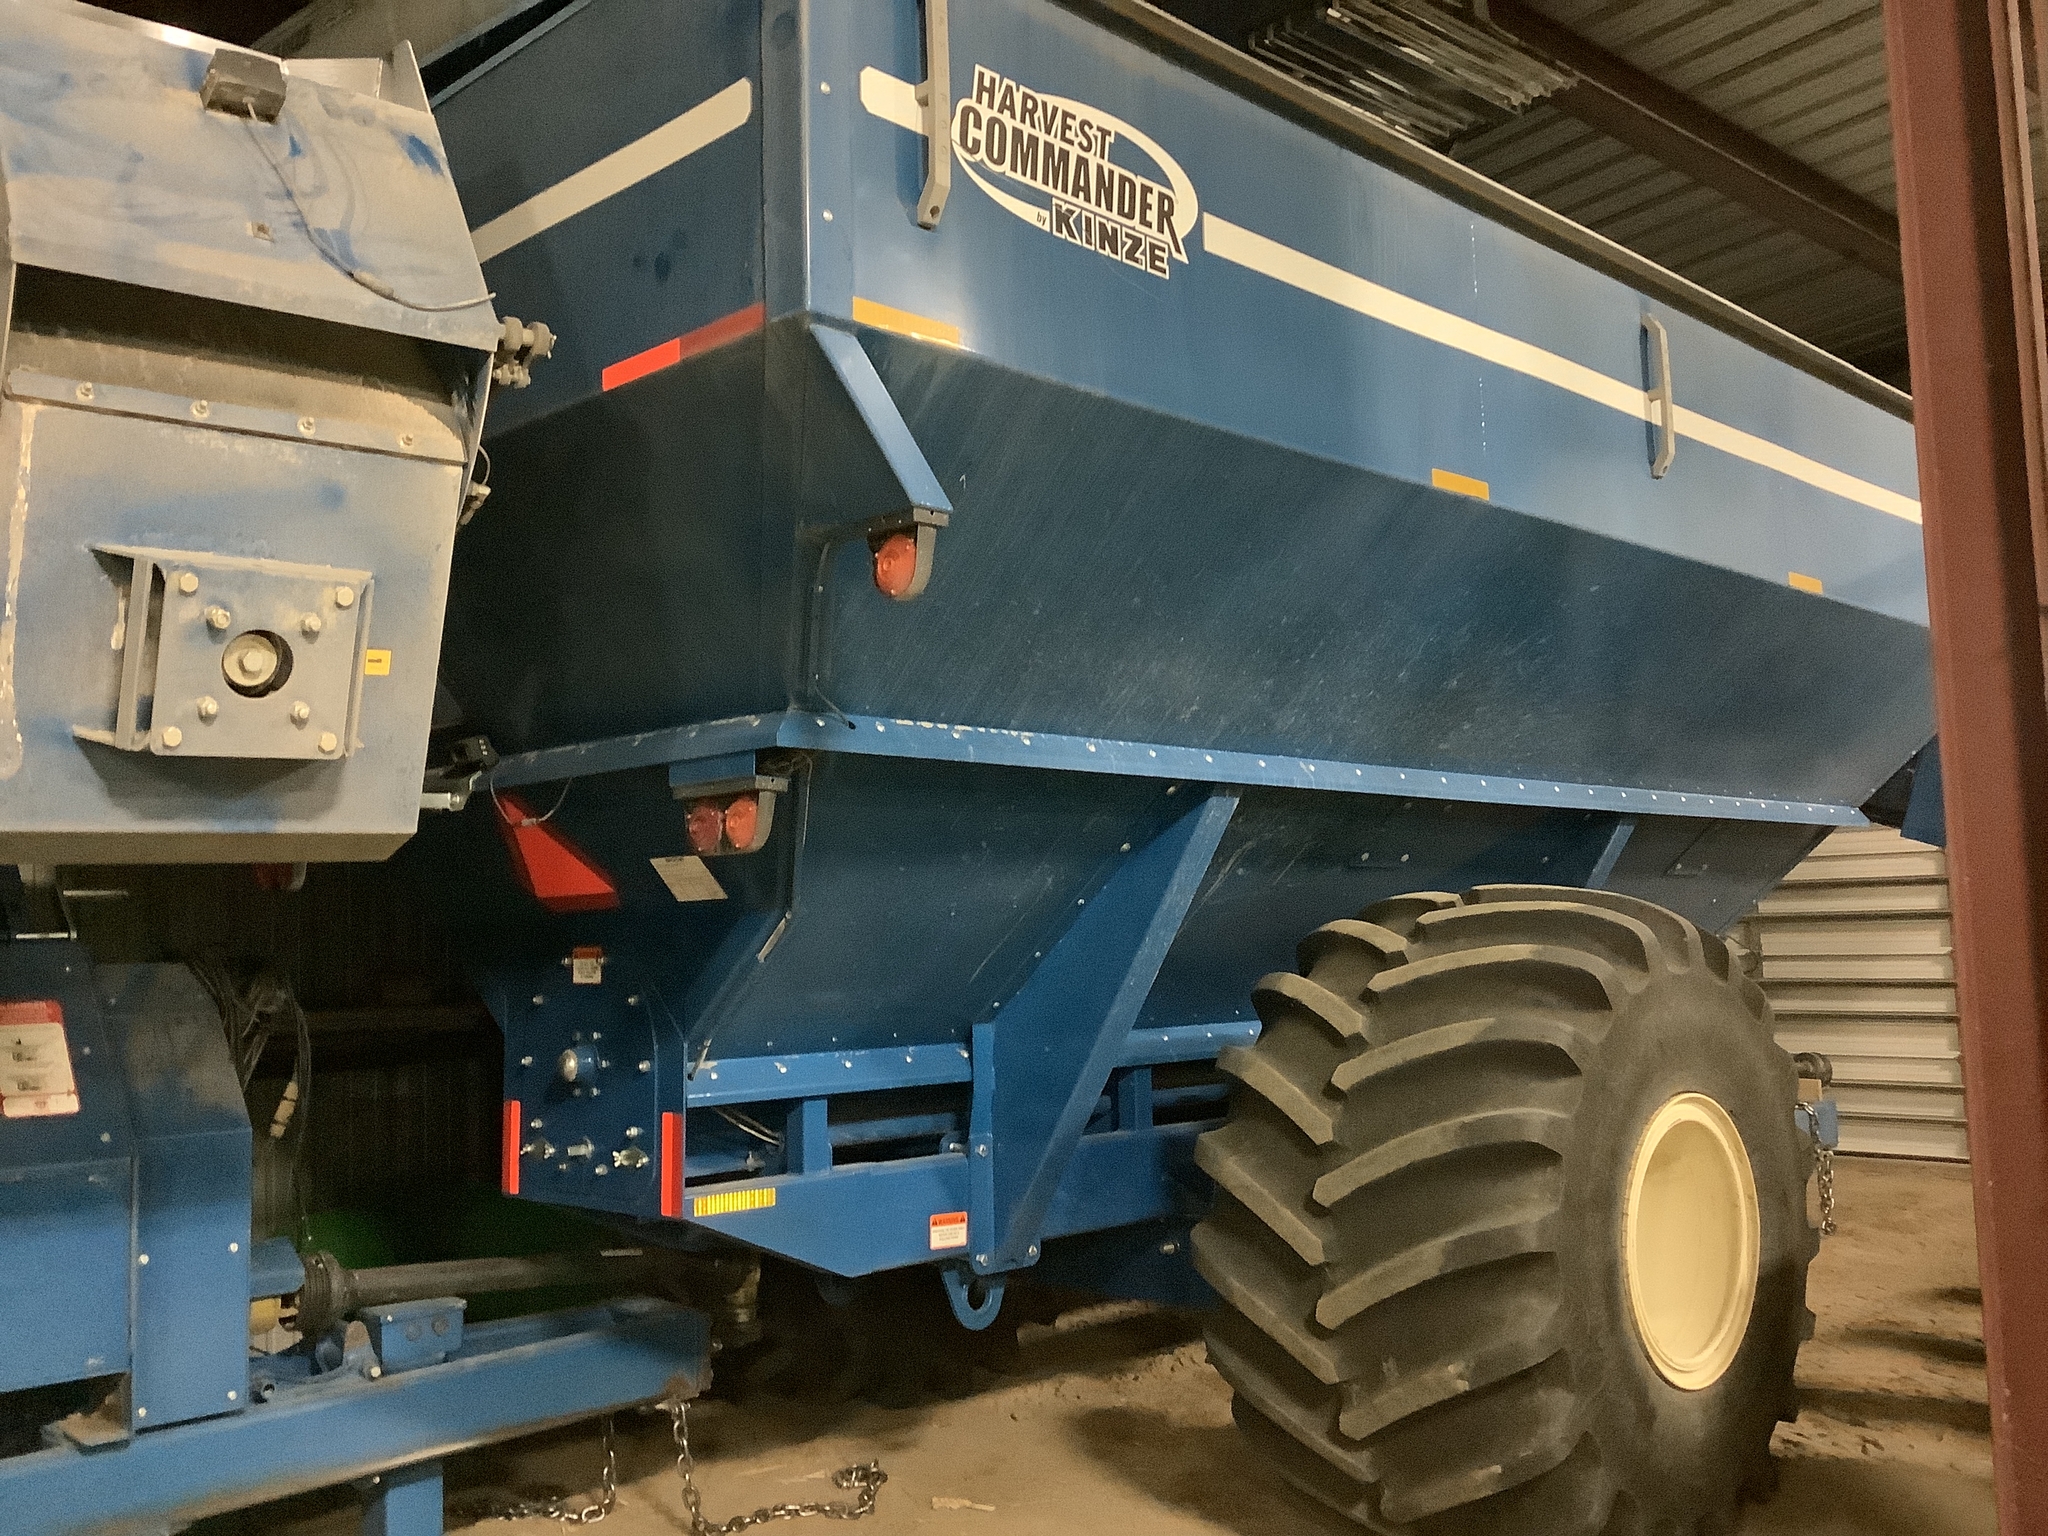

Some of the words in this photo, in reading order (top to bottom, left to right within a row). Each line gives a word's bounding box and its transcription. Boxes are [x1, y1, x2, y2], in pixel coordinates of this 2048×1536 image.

[975, 70, 1111, 159] HARVEST
[958, 105, 1182, 256] COMMANDER
[1036, 211, 1047, 226] by
[1053, 203, 1167, 275] KINZE
